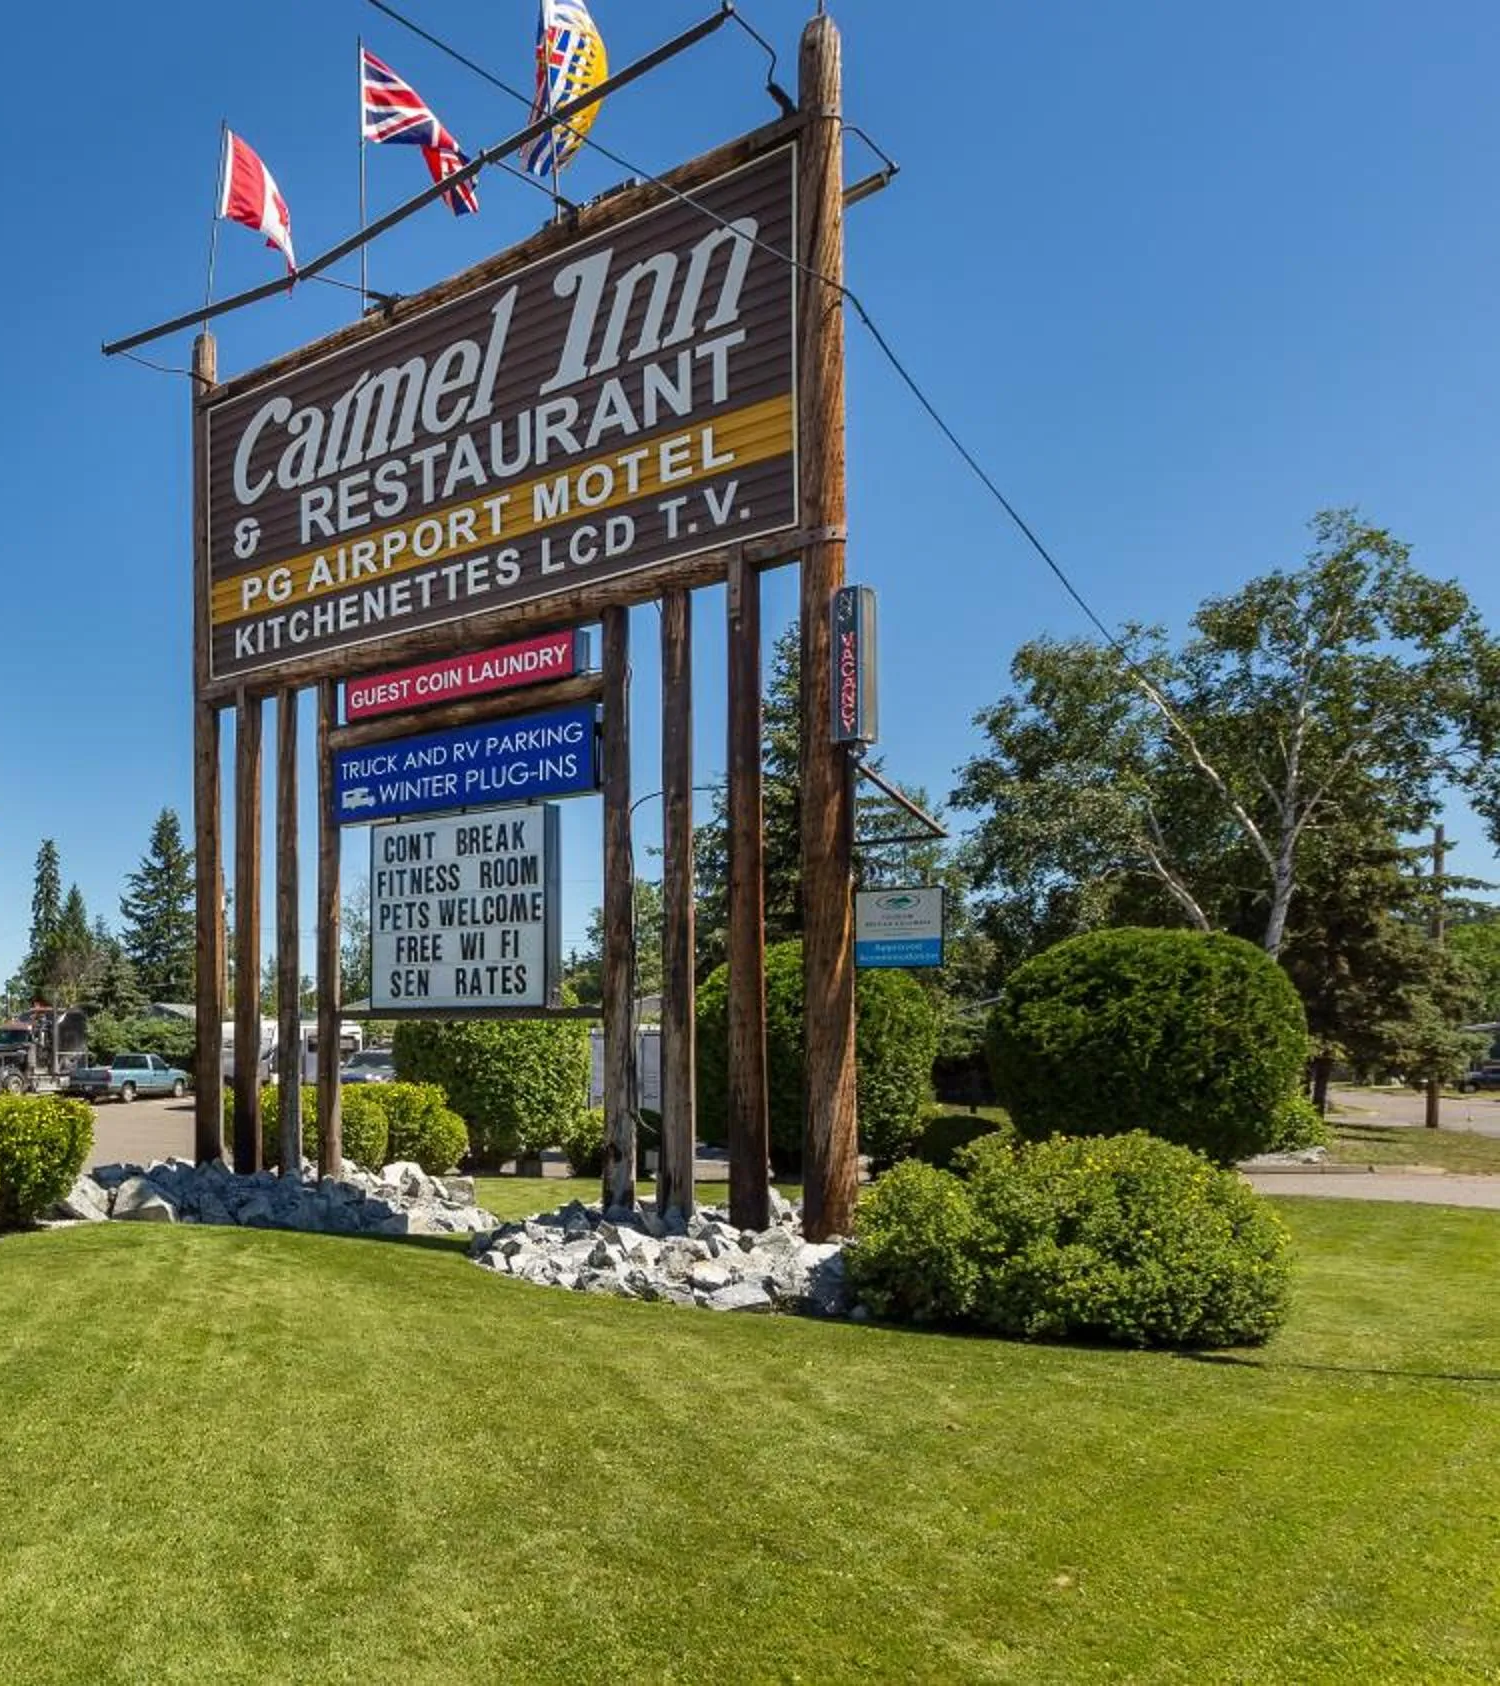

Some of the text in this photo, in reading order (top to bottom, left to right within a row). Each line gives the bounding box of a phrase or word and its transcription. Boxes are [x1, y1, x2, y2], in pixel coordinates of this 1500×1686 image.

[232, 217, 759, 505] Carmel Inn
[233, 329, 746, 559] & RESTAURANT
[242, 427, 735, 610] PG AIRPORT MOTEL
[234, 481, 752, 659] KITCHENETTES LCD T.V.
[351, 645, 569, 709] GUEST COIN LAUNDRY
[840, 631, 856, 733] VACANCY
[341, 722, 583, 781] TRUCK AND RV PARKING
[379, 754, 578, 804] WINTER PLUG-INS
[383, 821, 526, 864] CONT BREAK
[377, 855, 539, 897] FITNESS ROOM
[379, 892, 543, 931] PETS WELCOME
[396, 929, 519, 964] FREE WI FI
[390, 964, 528, 997] SEN RATES
